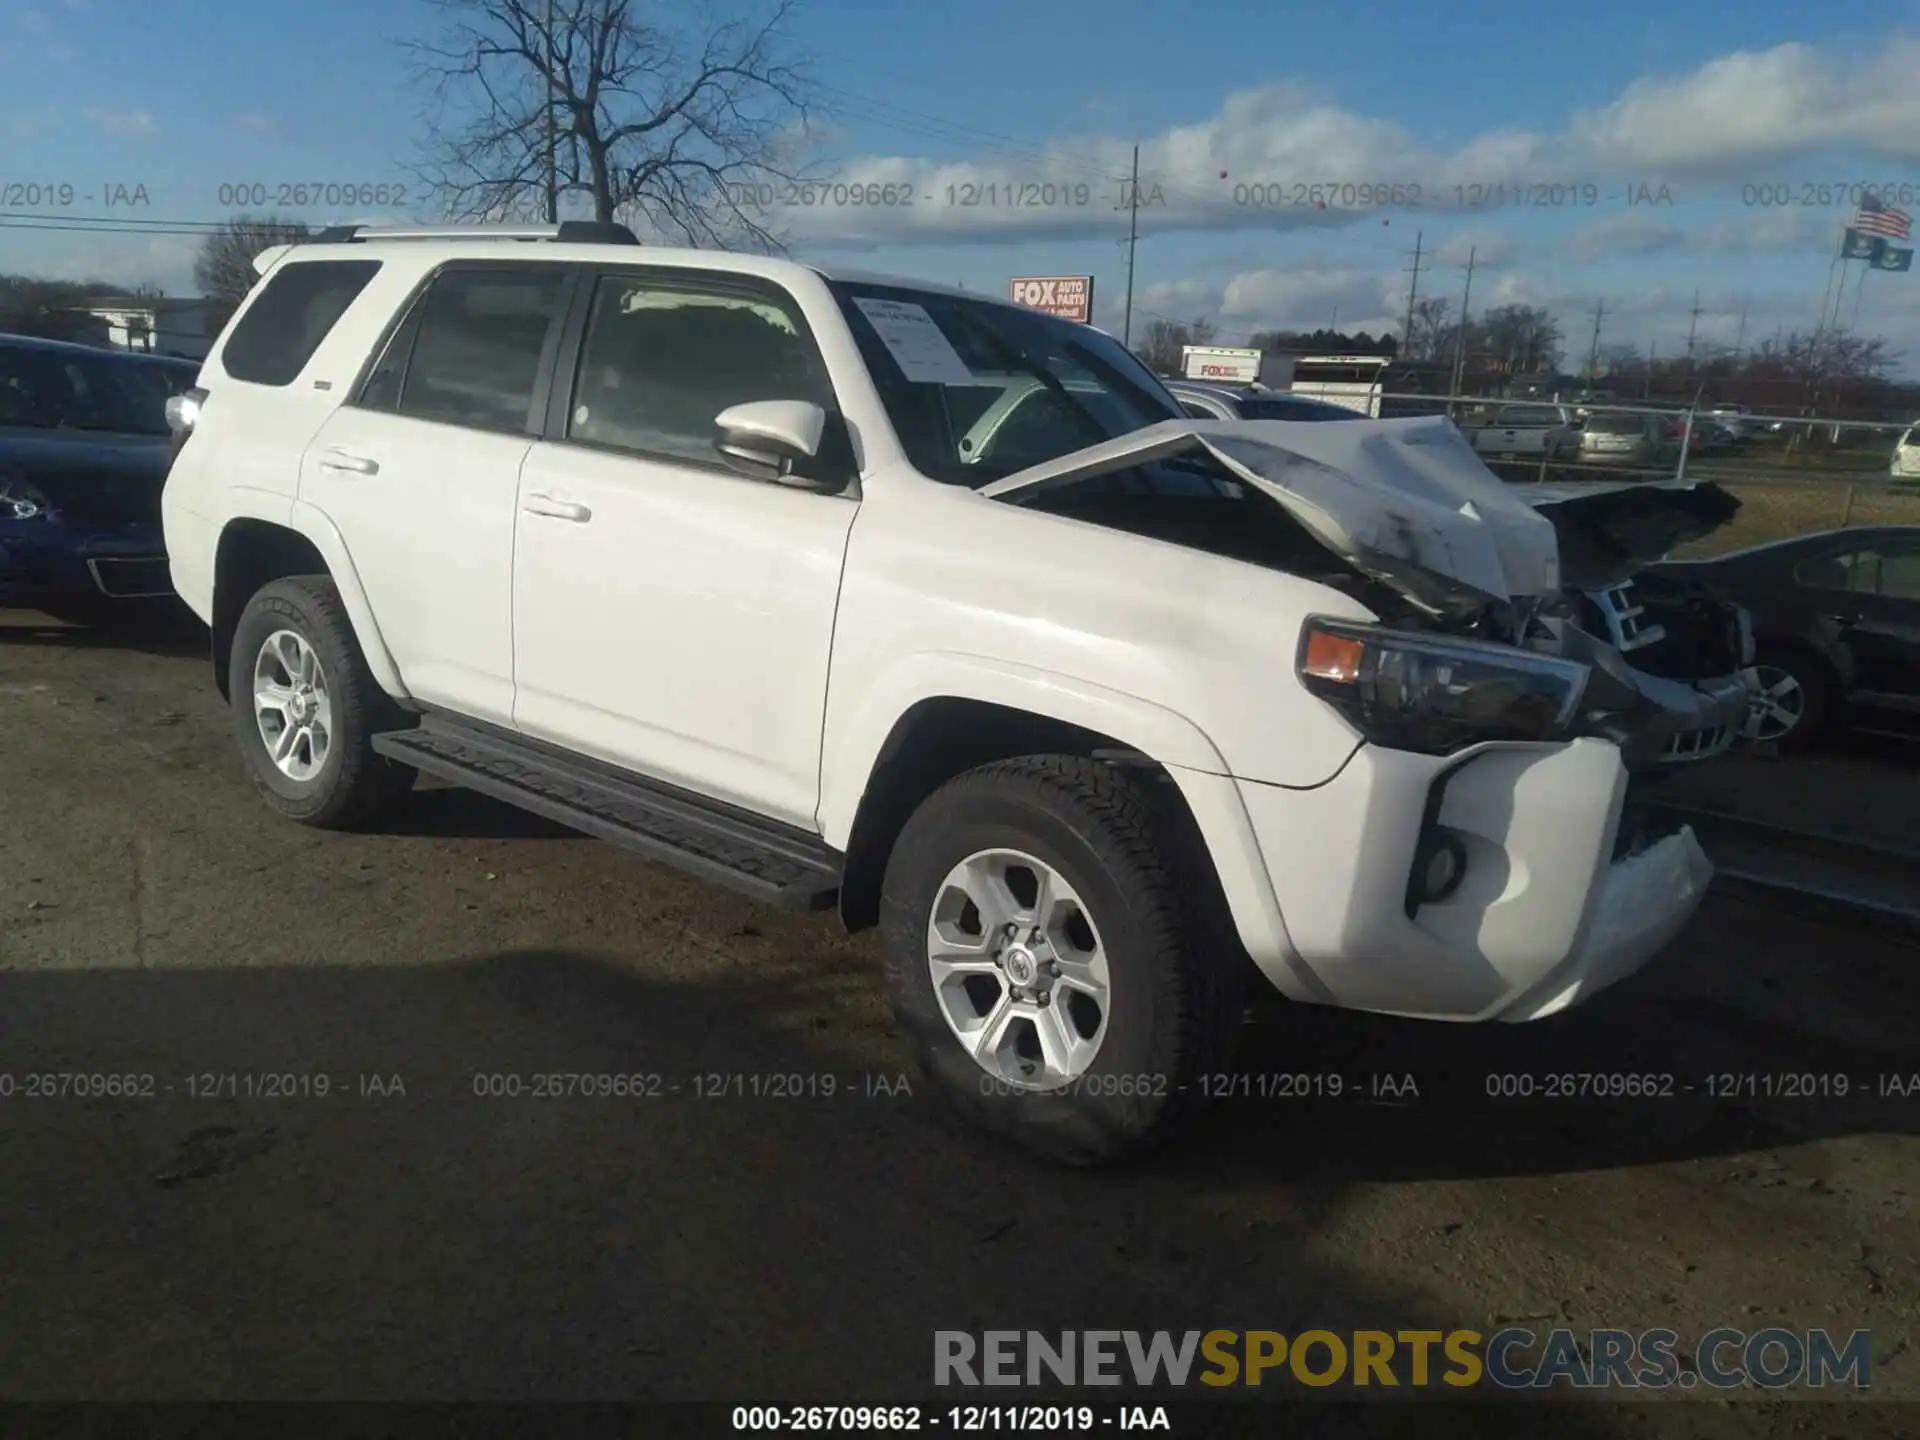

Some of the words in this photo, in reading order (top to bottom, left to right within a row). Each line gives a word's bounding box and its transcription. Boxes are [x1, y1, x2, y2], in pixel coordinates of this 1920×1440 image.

[1058, 281, 1083, 293] AUTO
[1013, 282, 1056, 306] FOX
[1057, 294, 1085, 306] PARTS
[1201, 365, 1226, 377] FOX
